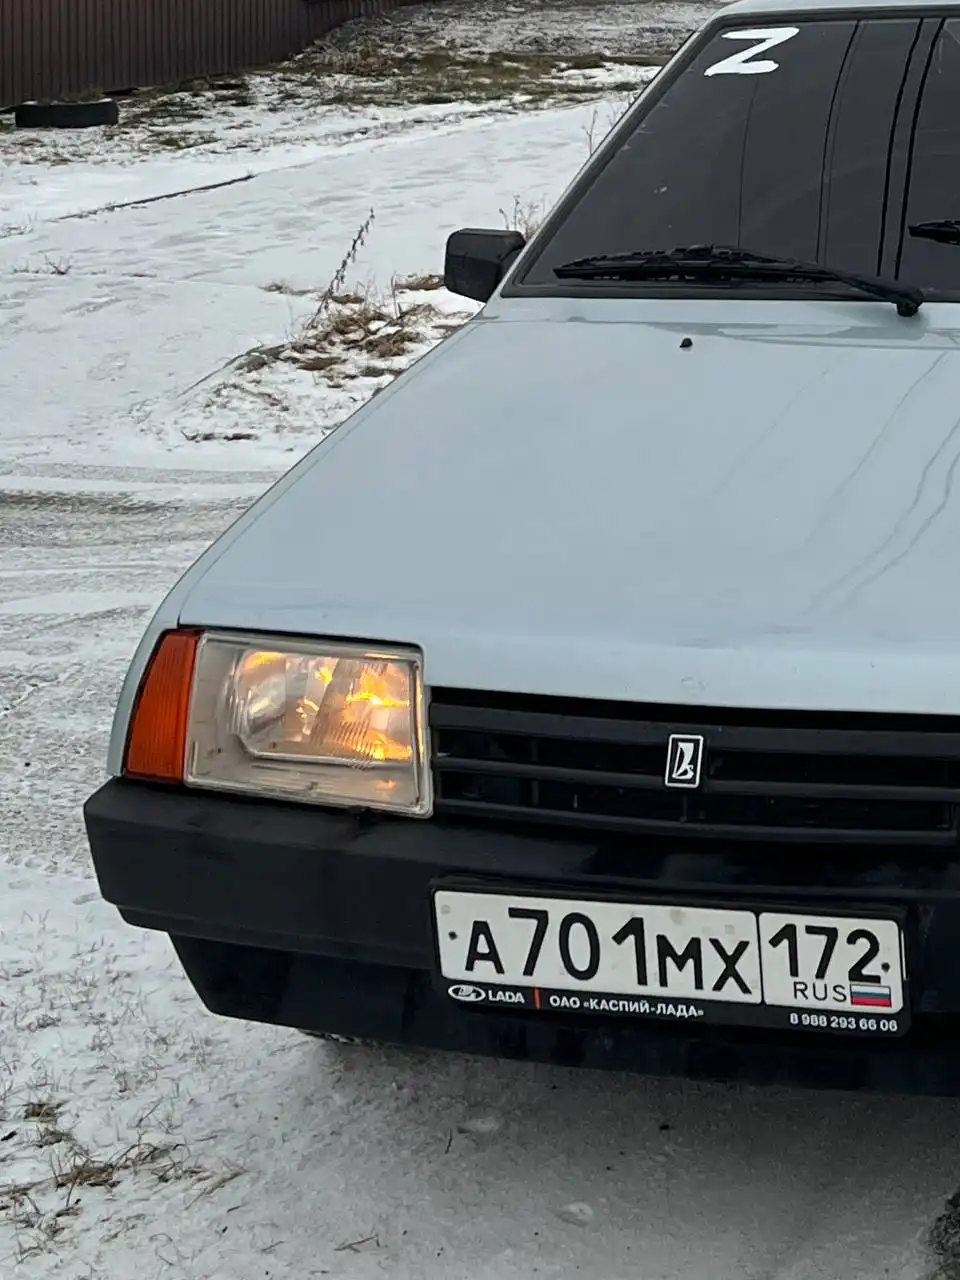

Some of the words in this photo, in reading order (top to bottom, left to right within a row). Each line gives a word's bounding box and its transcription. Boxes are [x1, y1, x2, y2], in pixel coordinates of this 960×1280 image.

[704, 26, 800, 76] Z
[768, 923, 881, 984] 172
[488, 991, 526, 1004] LADA
[793, 981, 847, 1002] RUS
[549, 994, 580, 1009] ОАО
[583, 997, 704, 1018] «КАСПИЙ-ЛАДА»
[830, 1016, 857, 1029] 293
[880, 1019, 898, 1032] 06
